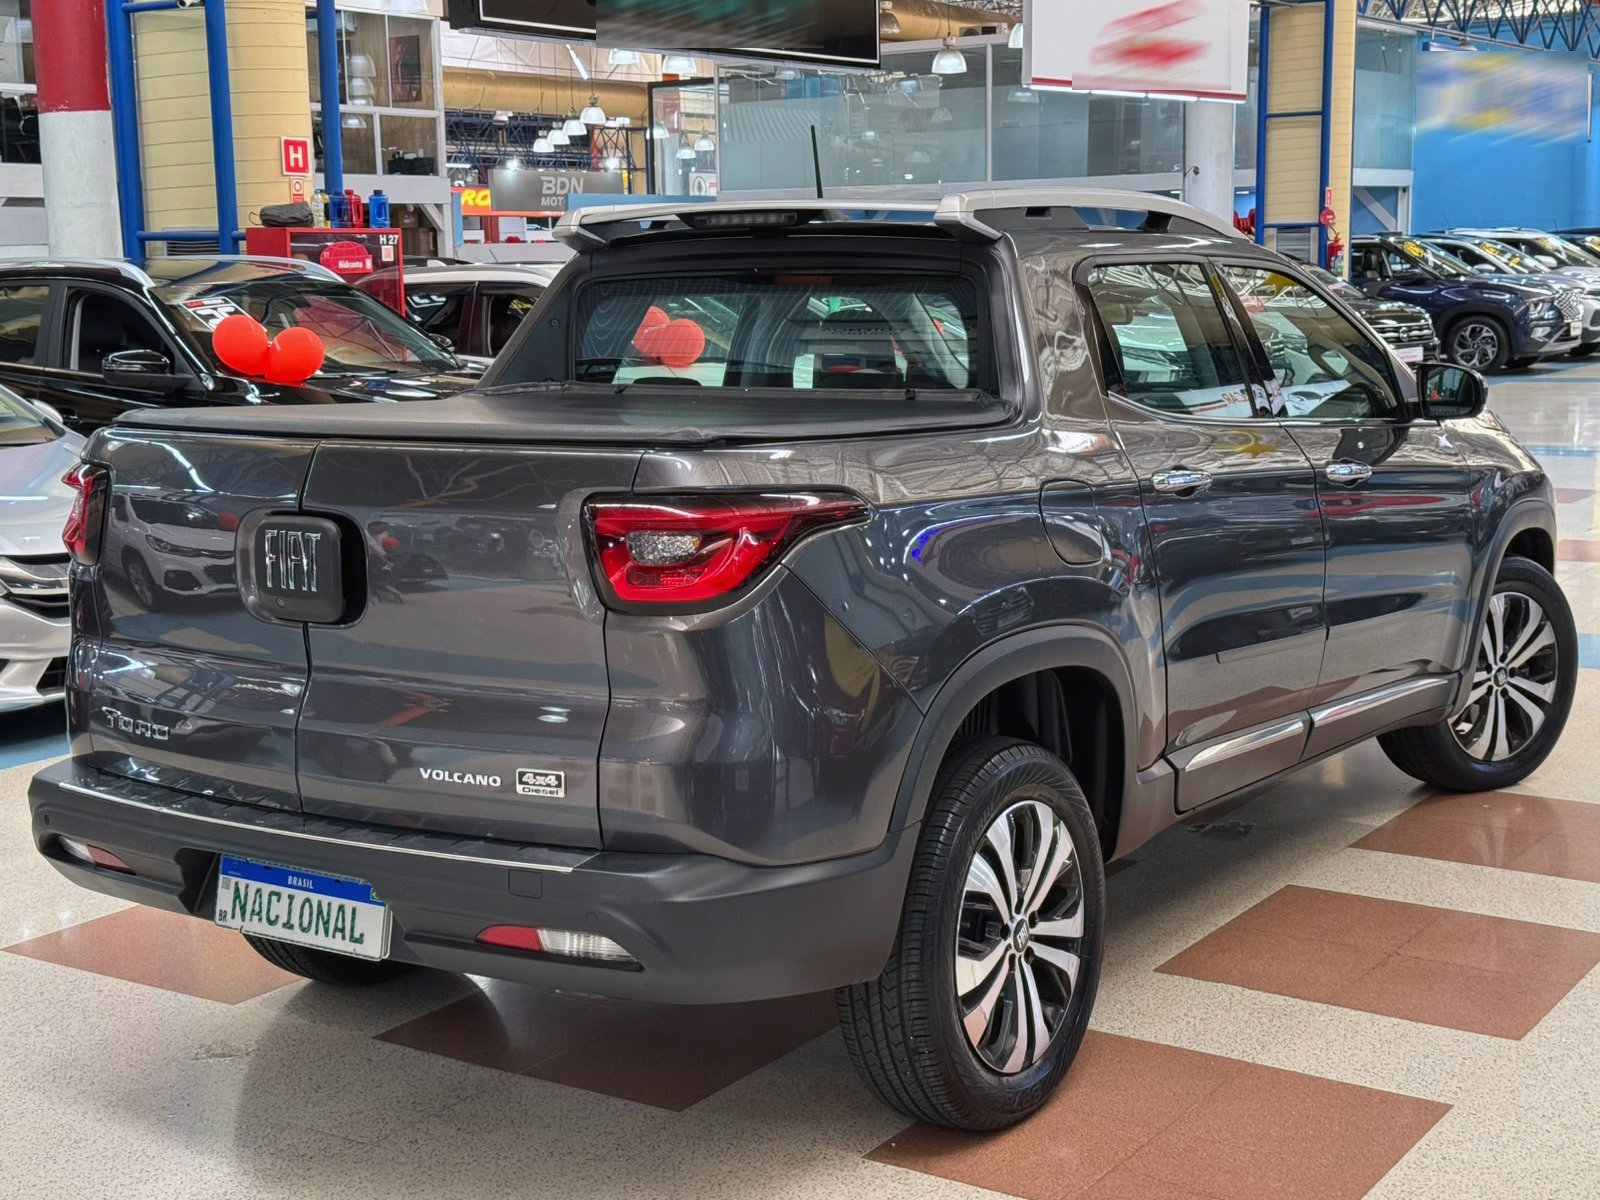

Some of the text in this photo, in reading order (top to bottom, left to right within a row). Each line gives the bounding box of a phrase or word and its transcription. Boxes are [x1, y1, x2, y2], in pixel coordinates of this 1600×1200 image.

[289, 144, 303, 168] H
[540, 175, 584, 195] BDN
[379, 234, 399, 245] H 27
[265, 530, 321, 591] FIAT
[101, 706, 168, 740] TORO
[419, 768, 501, 787] VOLCANO
[522, 772, 559, 786] 4x4
[522, 786, 559, 796] Diesel
[287, 875, 314, 890] BRASIL
[218, 909, 228, 923] BR
[231, 881, 365, 945] NACIONAL
